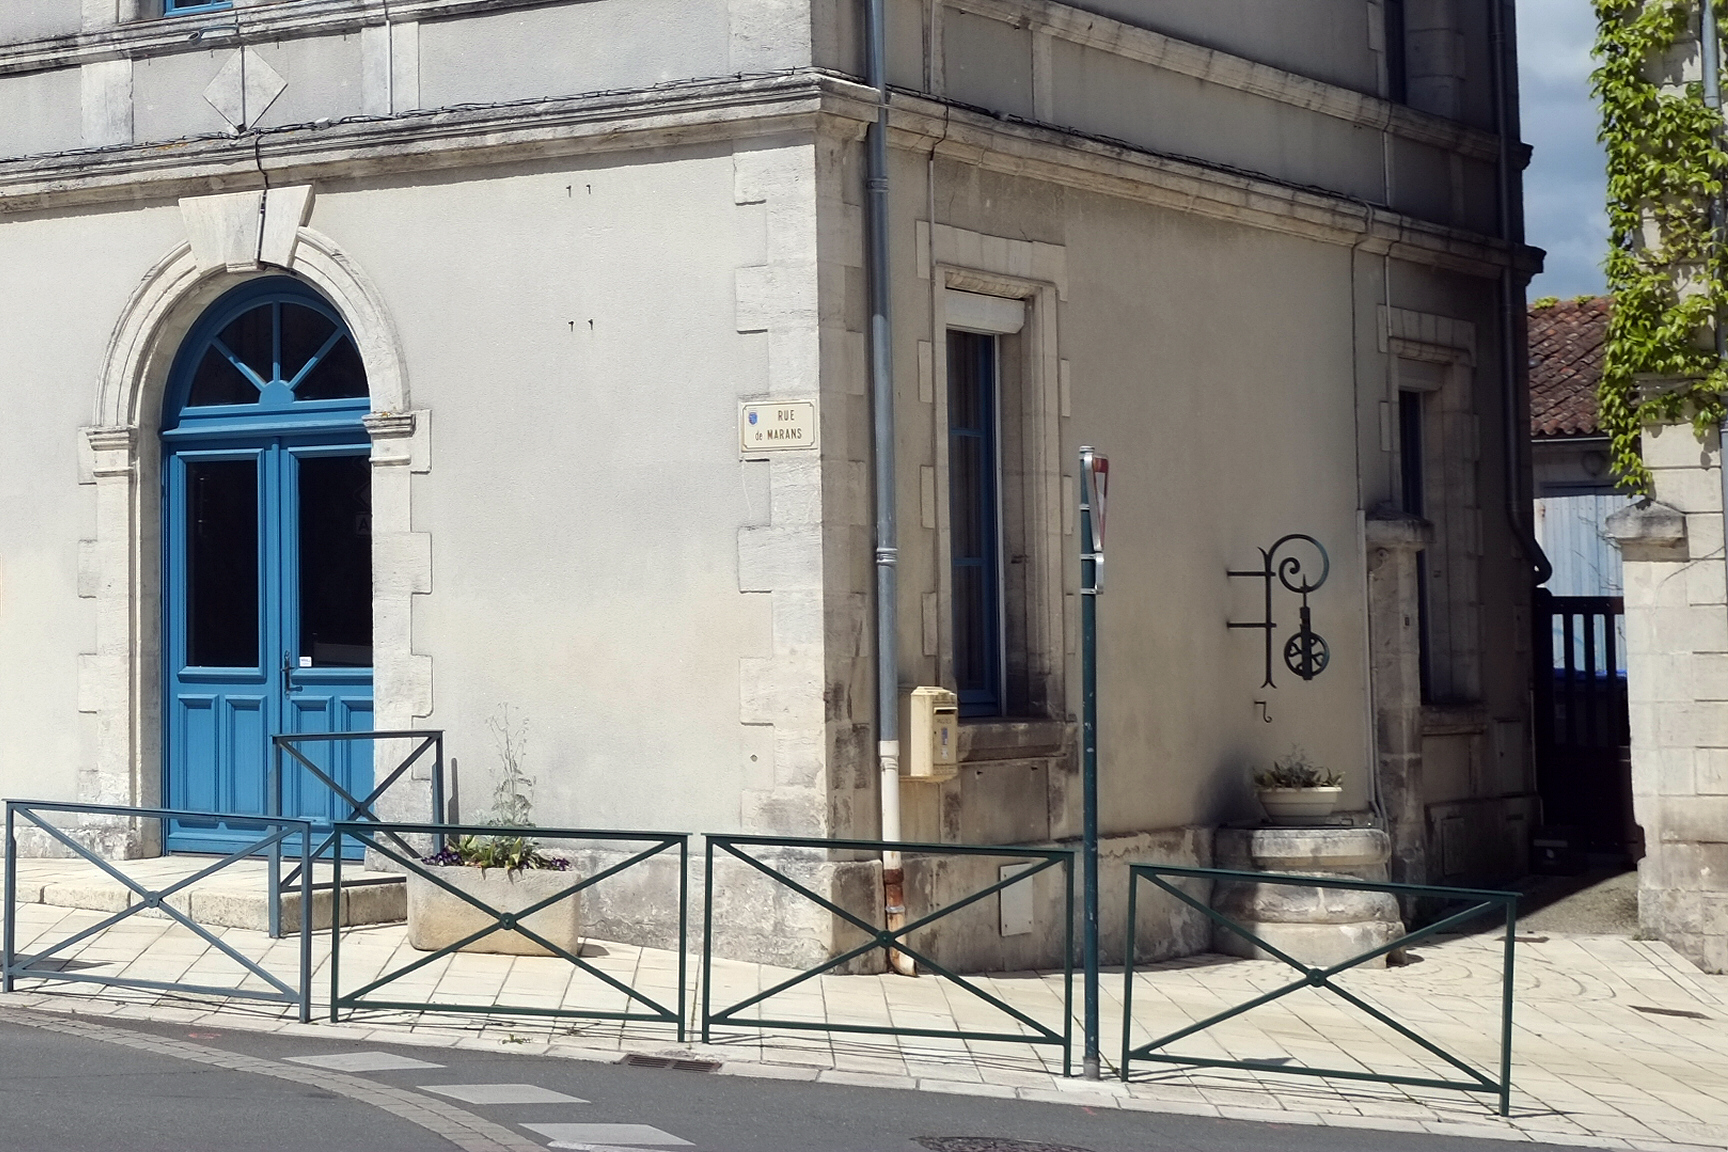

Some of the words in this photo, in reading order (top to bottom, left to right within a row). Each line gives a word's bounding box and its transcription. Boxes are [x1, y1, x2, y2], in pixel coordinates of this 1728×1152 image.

[777, 410, 795, 421] RUE
[755, 431, 763, 441] de
[767, 428, 802, 440] MARANS
